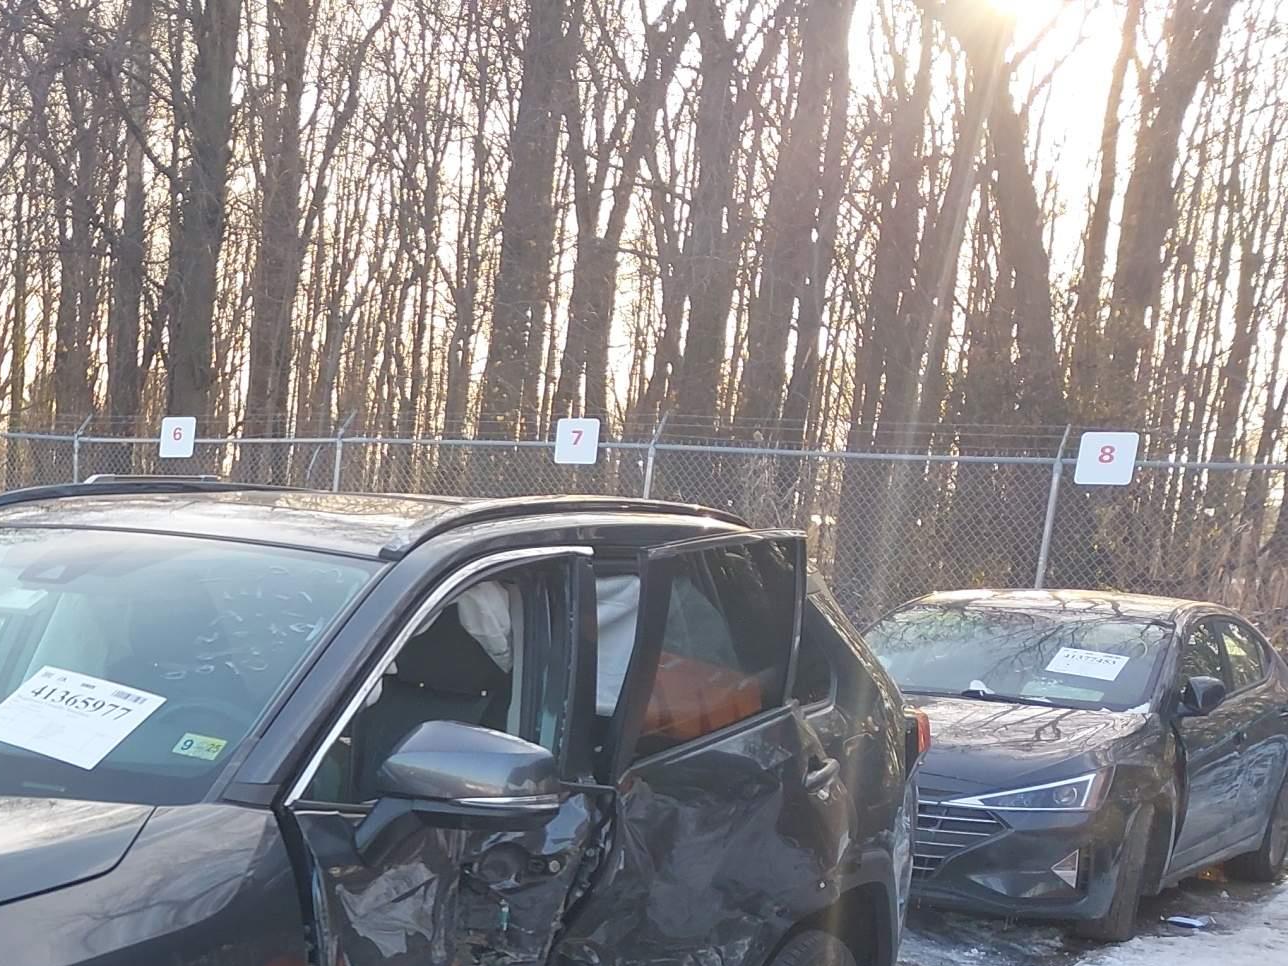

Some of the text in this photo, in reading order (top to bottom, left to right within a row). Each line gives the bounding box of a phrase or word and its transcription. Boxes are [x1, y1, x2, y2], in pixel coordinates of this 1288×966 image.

[172, 427, 183, 441] 6
[571, 430, 584, 446] 7
[1098, 446, 1115, 464] 8
[31, 684, 132, 721] 41365977
[180, 739, 194, 751] 9
